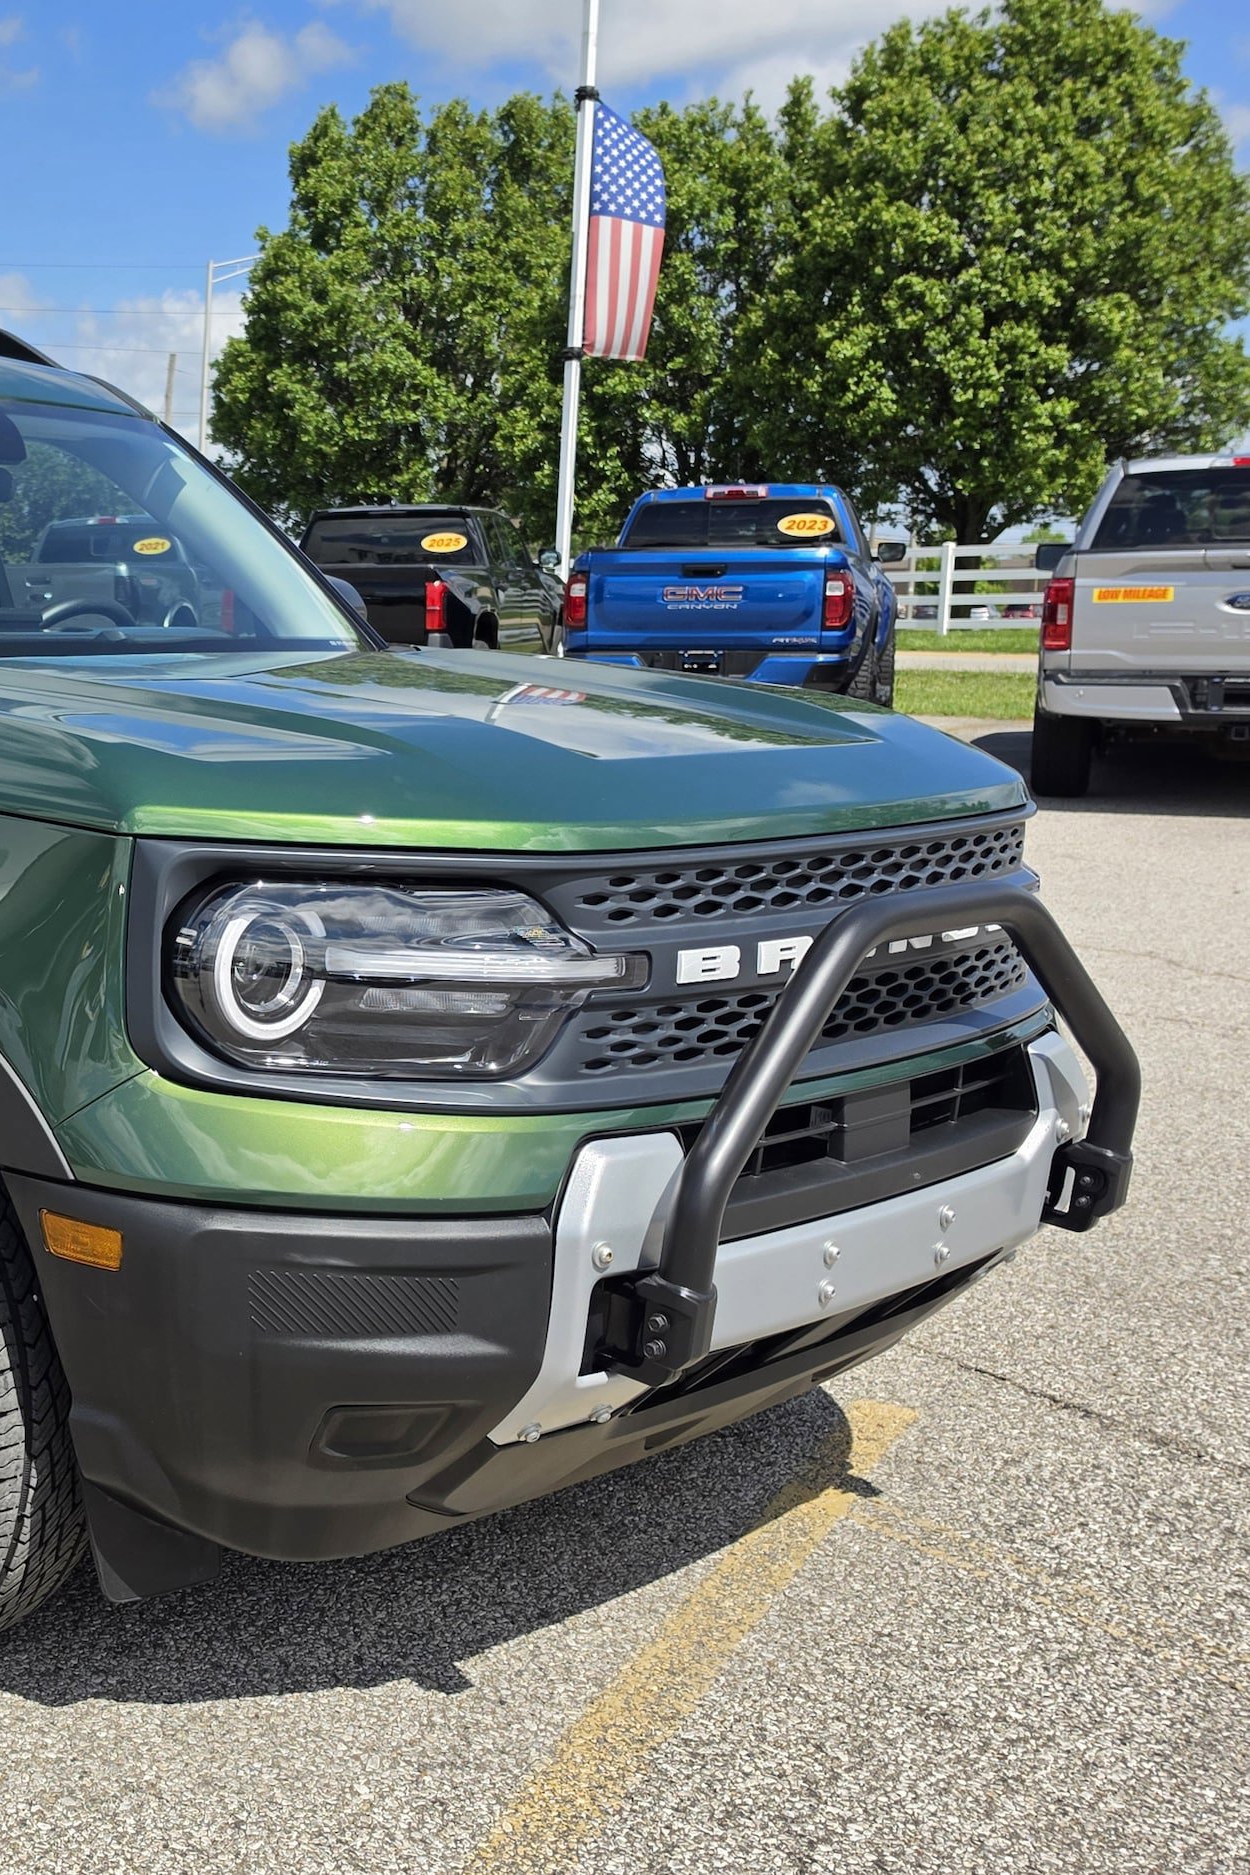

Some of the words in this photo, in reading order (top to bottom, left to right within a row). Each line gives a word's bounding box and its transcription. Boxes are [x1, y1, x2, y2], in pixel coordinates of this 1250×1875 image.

[785, 519, 829, 531] 2023
[428, 537, 462, 548] 2025
[663, 586, 744, 602] GMC
[1097, 589, 1121, 601] LOW
[1122, 587, 1168, 600] MILEAGE
